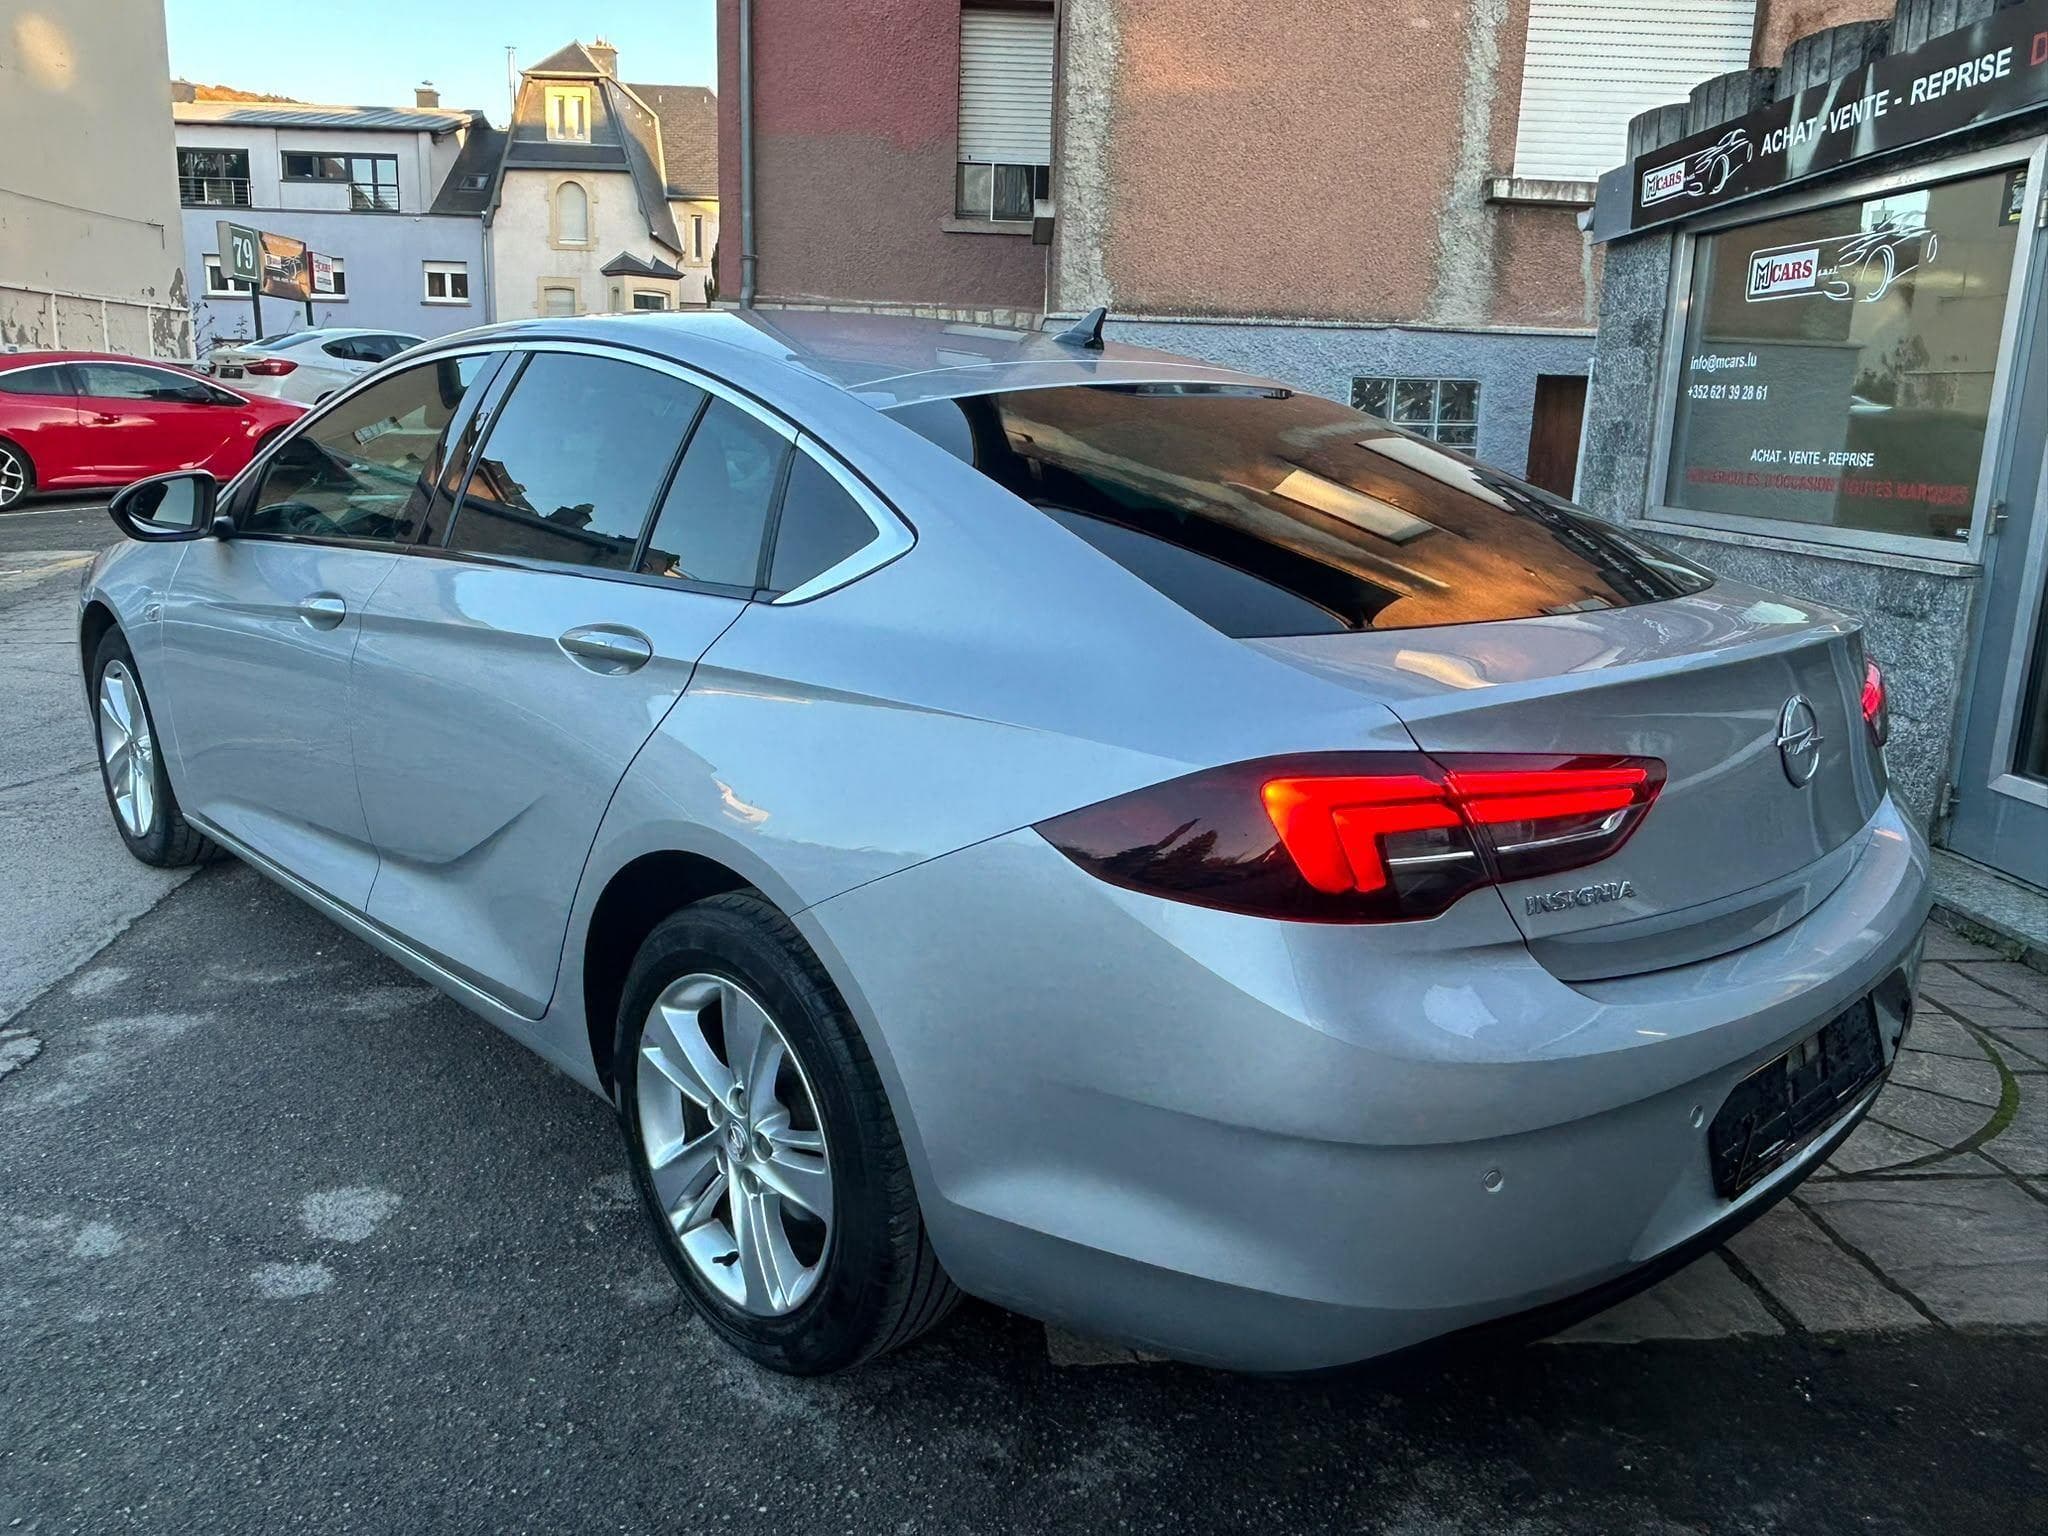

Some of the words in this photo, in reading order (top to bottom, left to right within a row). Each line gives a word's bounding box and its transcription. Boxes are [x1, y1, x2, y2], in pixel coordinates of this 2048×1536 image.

[1760, 117, 1818, 157] ACHAT
[1830, 89, 1890, 134] VENTE
[1910, 46, 2013, 106] REPRISE
[232, 236, 253, 270] 79
[1690, 352, 1757, 373] info@mcars.lu
[1688, 384, 1709, 399] +352
[1710, 385, 1726, 399] 621
[1728, 385, 1740, 400] 39
[1741, 385, 1754, 400] 28
[1756, 385, 1768, 400] 61
[1750, 448, 1782, 463] ACHAT
[1788, 450, 1820, 465] VENTE
[1828, 452, 1874, 468] REPRISE
[1525, 880, 1637, 915] INSIGNIA
